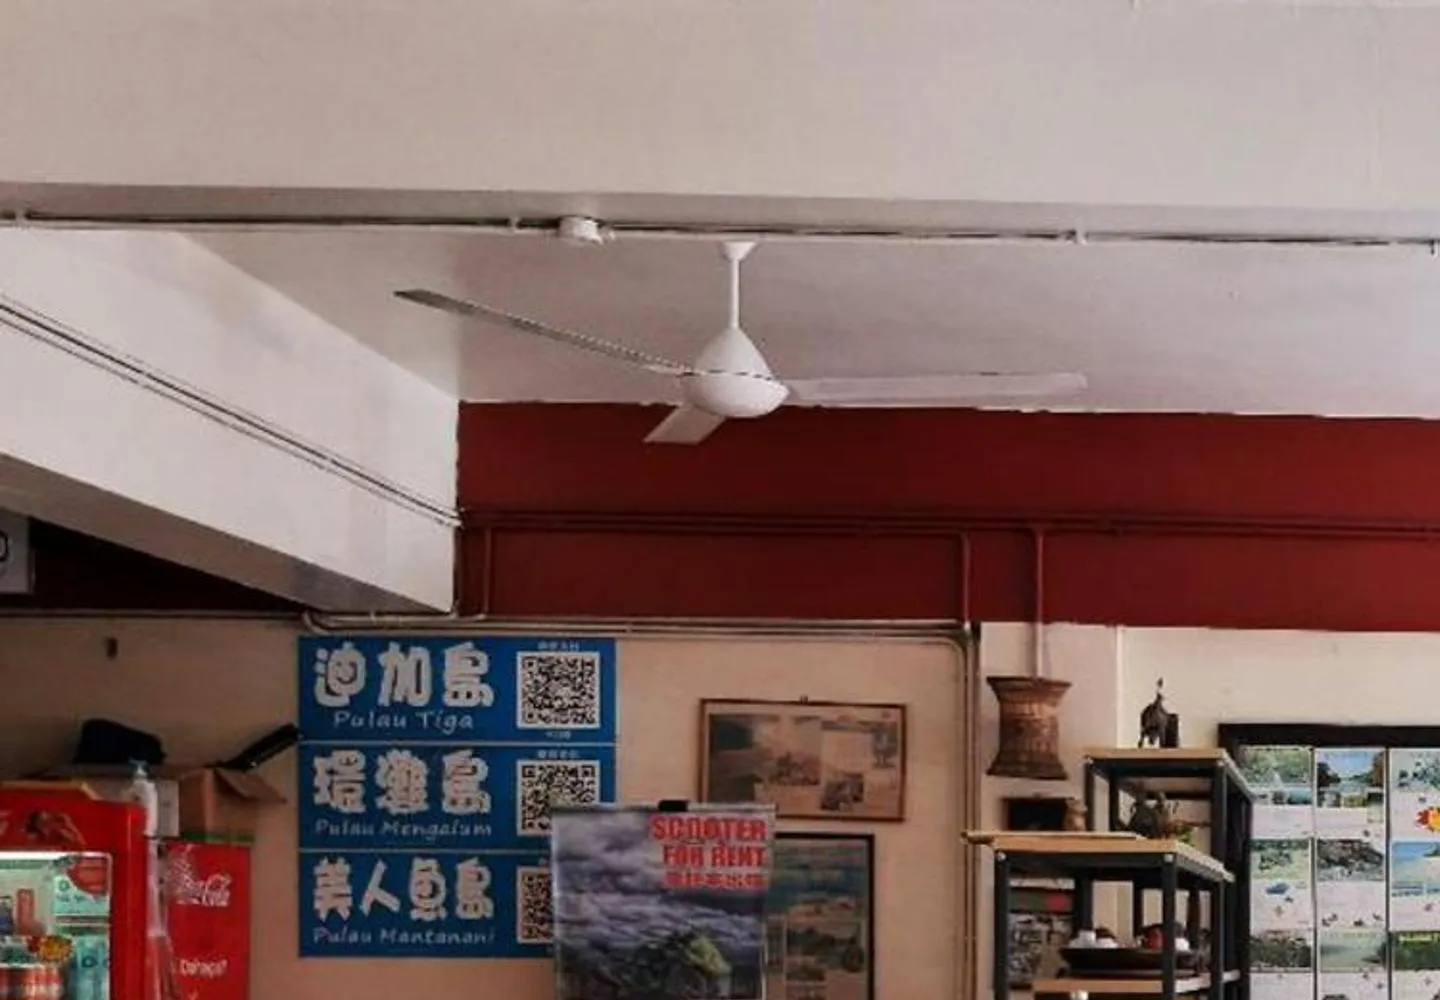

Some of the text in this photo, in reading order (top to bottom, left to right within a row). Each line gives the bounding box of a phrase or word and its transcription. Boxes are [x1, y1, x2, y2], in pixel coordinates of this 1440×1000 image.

[333, 709, 474, 735] Pulau Tiga
[315, 819, 492, 841] Pulau Mengalum
[652, 815, 766, 840] SCOOTER
[663, 844, 766, 867] FOR RENT
[313, 926, 495, 944] Pulau Mantanani
